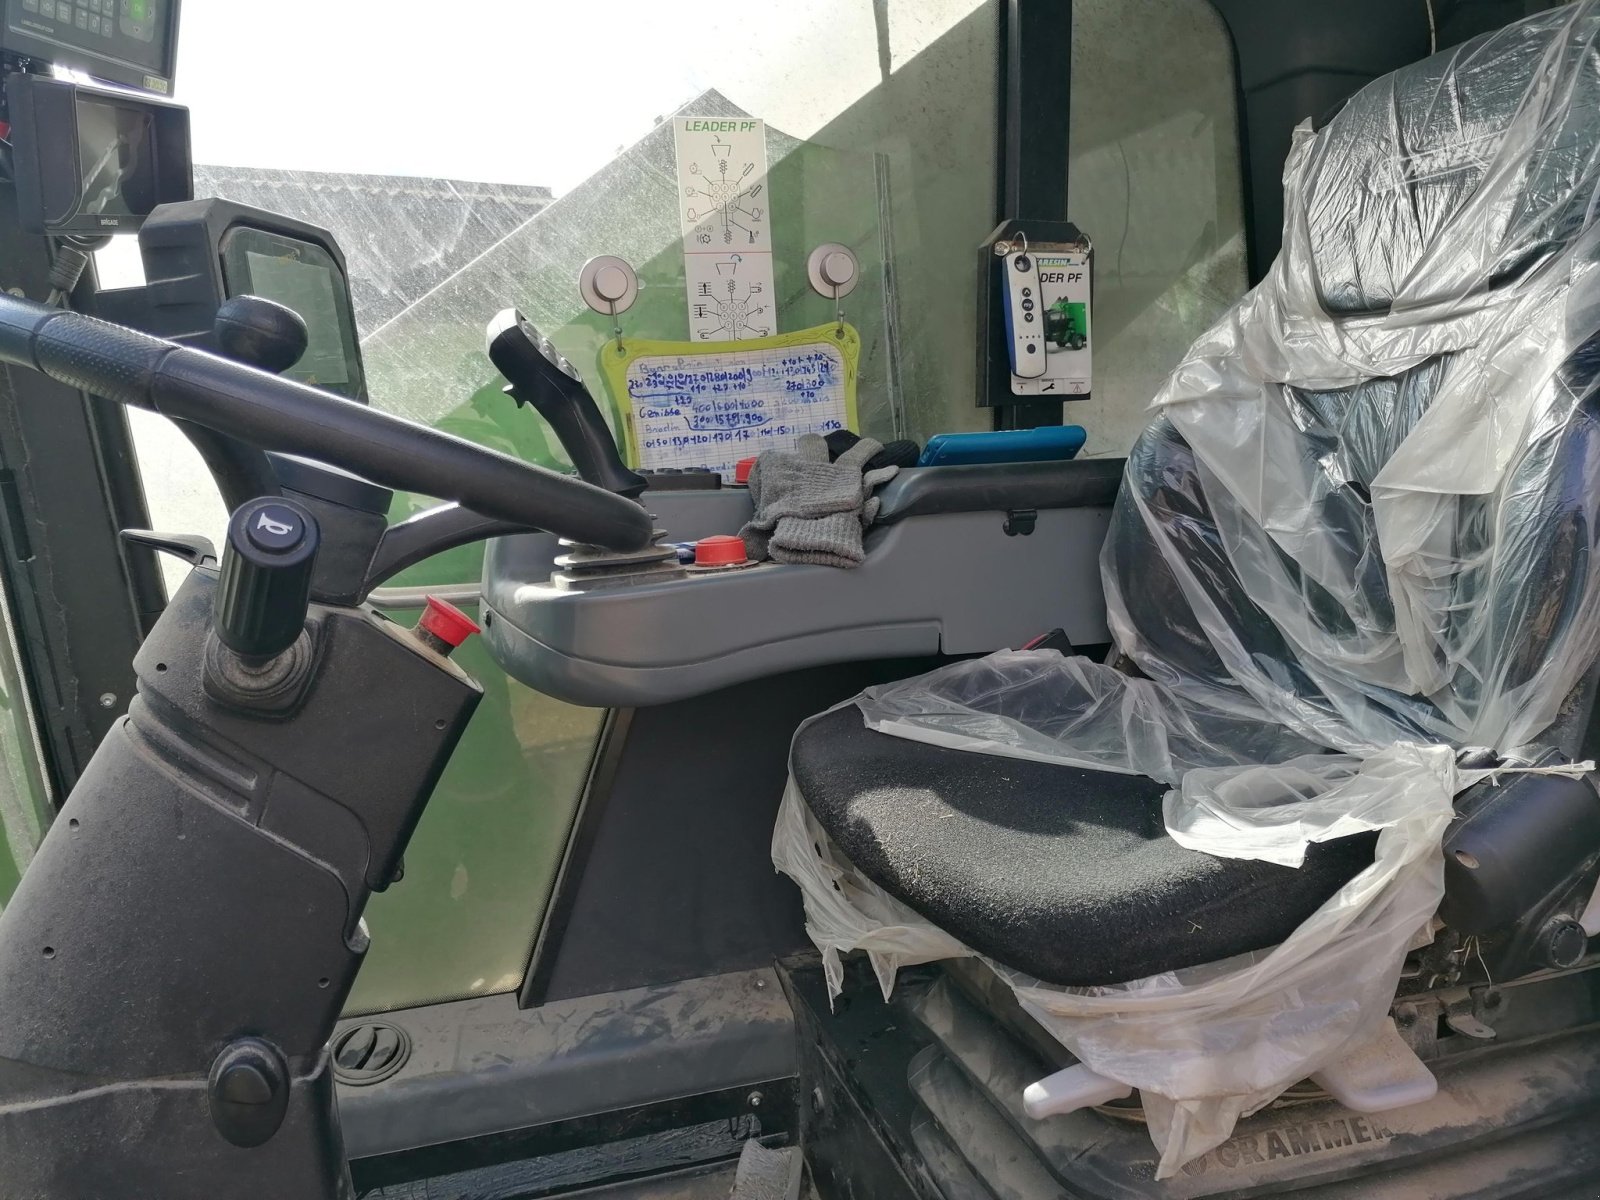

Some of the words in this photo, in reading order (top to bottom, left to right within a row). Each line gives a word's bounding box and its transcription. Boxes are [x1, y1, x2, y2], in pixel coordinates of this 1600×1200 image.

[685, 121, 737, 132] LEADER
[740, 121, 757, 132] PF
[1041, 273, 1064, 283] DER
[1067, 273, 1083, 283] PF
